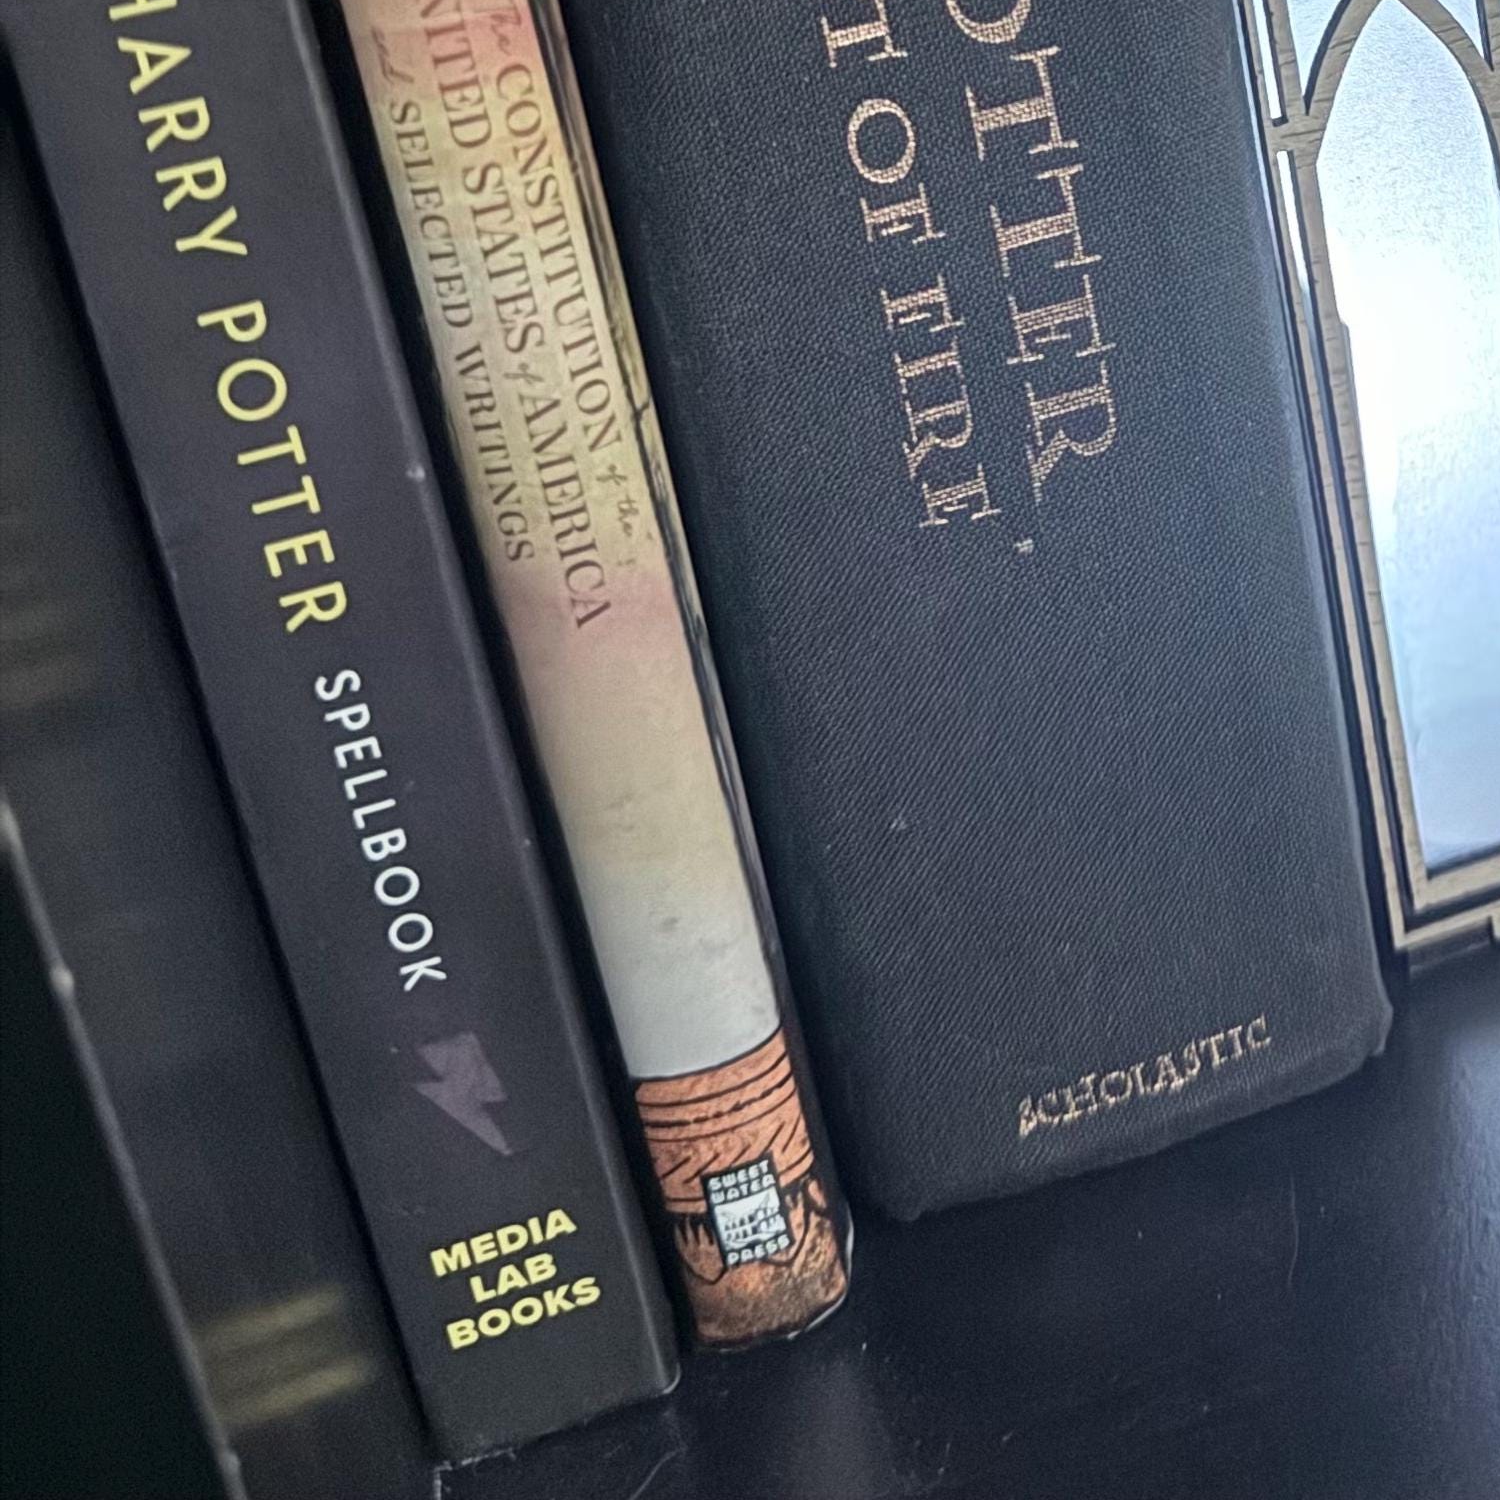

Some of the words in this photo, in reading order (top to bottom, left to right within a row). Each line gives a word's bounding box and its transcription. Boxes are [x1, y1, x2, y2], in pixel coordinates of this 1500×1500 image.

[846, 97, 947, 245] OF
[494, 61, 624, 453] CONSTITUTION
[388, 96, 474, 330] SELECTED
[452, 342, 536, 564] WRITINGS
[462, 157, 548, 356] STATES
[516, 387, 612, 628] AMERICA
[881, 273, 1001, 528] FIRE
[197, 300, 348, 633] POTTER
[314, 668, 448, 992] SPELLBOOK
[708, 1159, 770, 1192] SWEET
[710, 1173, 776, 1205] WATER
[429, 1208, 578, 1278] MEDIA
[469, 1252, 559, 1303] LAB
[726, 1233, 791, 1266] PRESS
[446, 1276, 602, 1351] BOOKS
